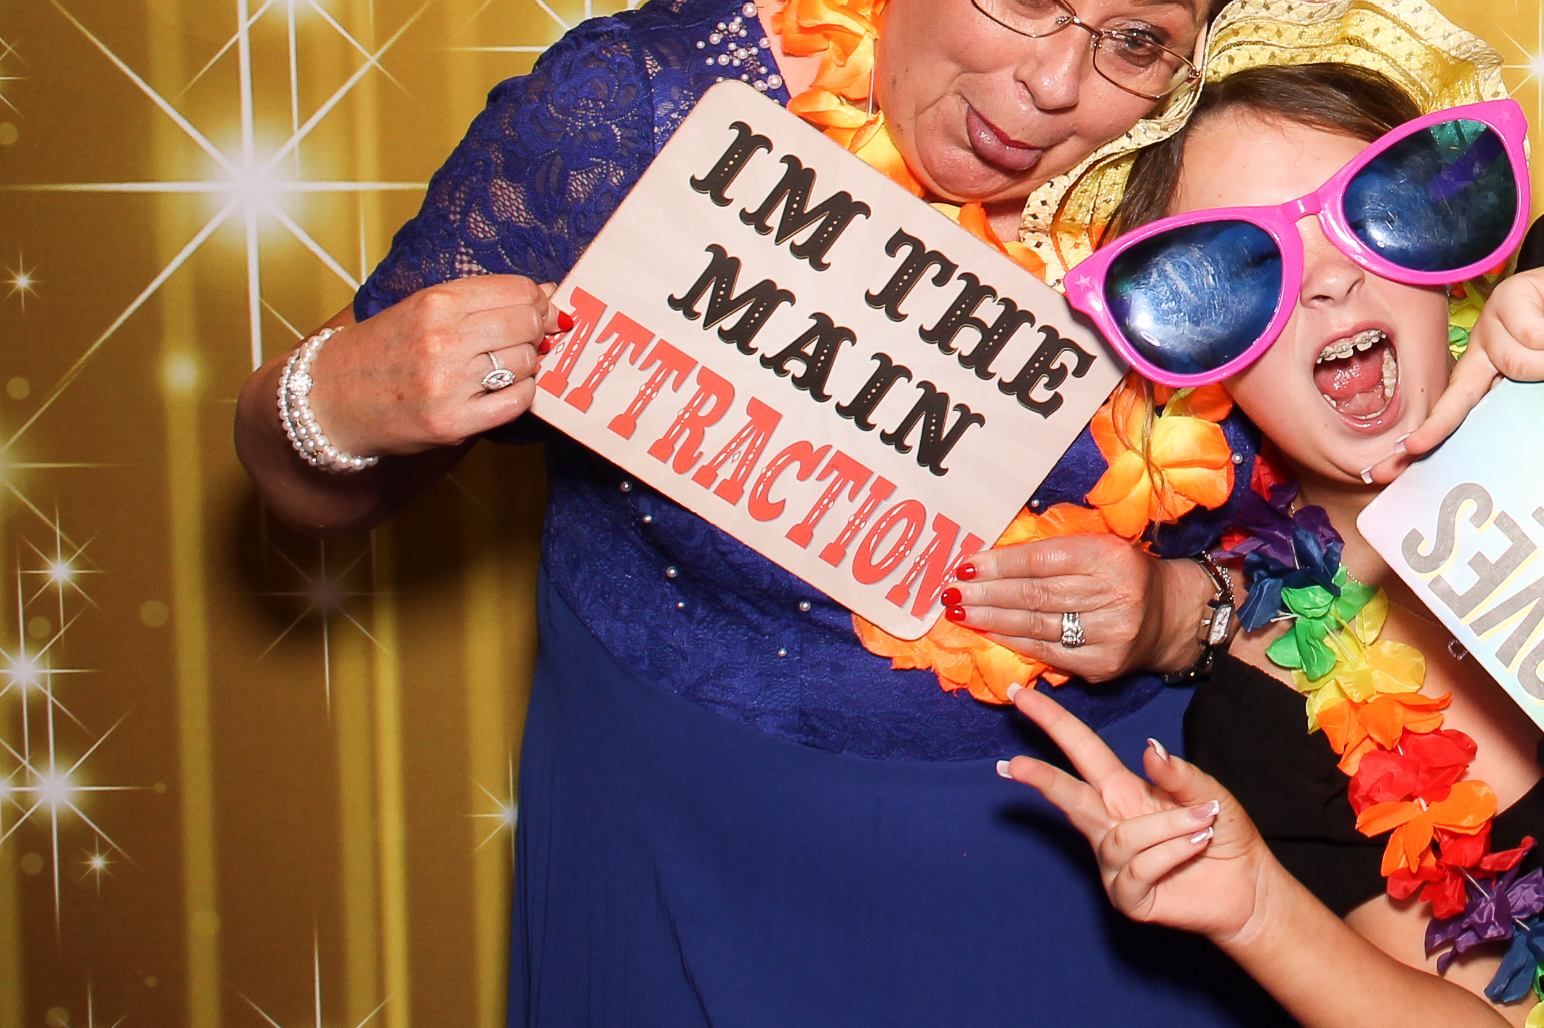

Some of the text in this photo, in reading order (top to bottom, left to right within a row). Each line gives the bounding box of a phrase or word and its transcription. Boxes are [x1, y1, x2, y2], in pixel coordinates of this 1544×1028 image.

[667, 243, 985, 476] MAIN
[689, 120, 1097, 420] IM THE
[535, 286, 985, 621] ATTRACTION
